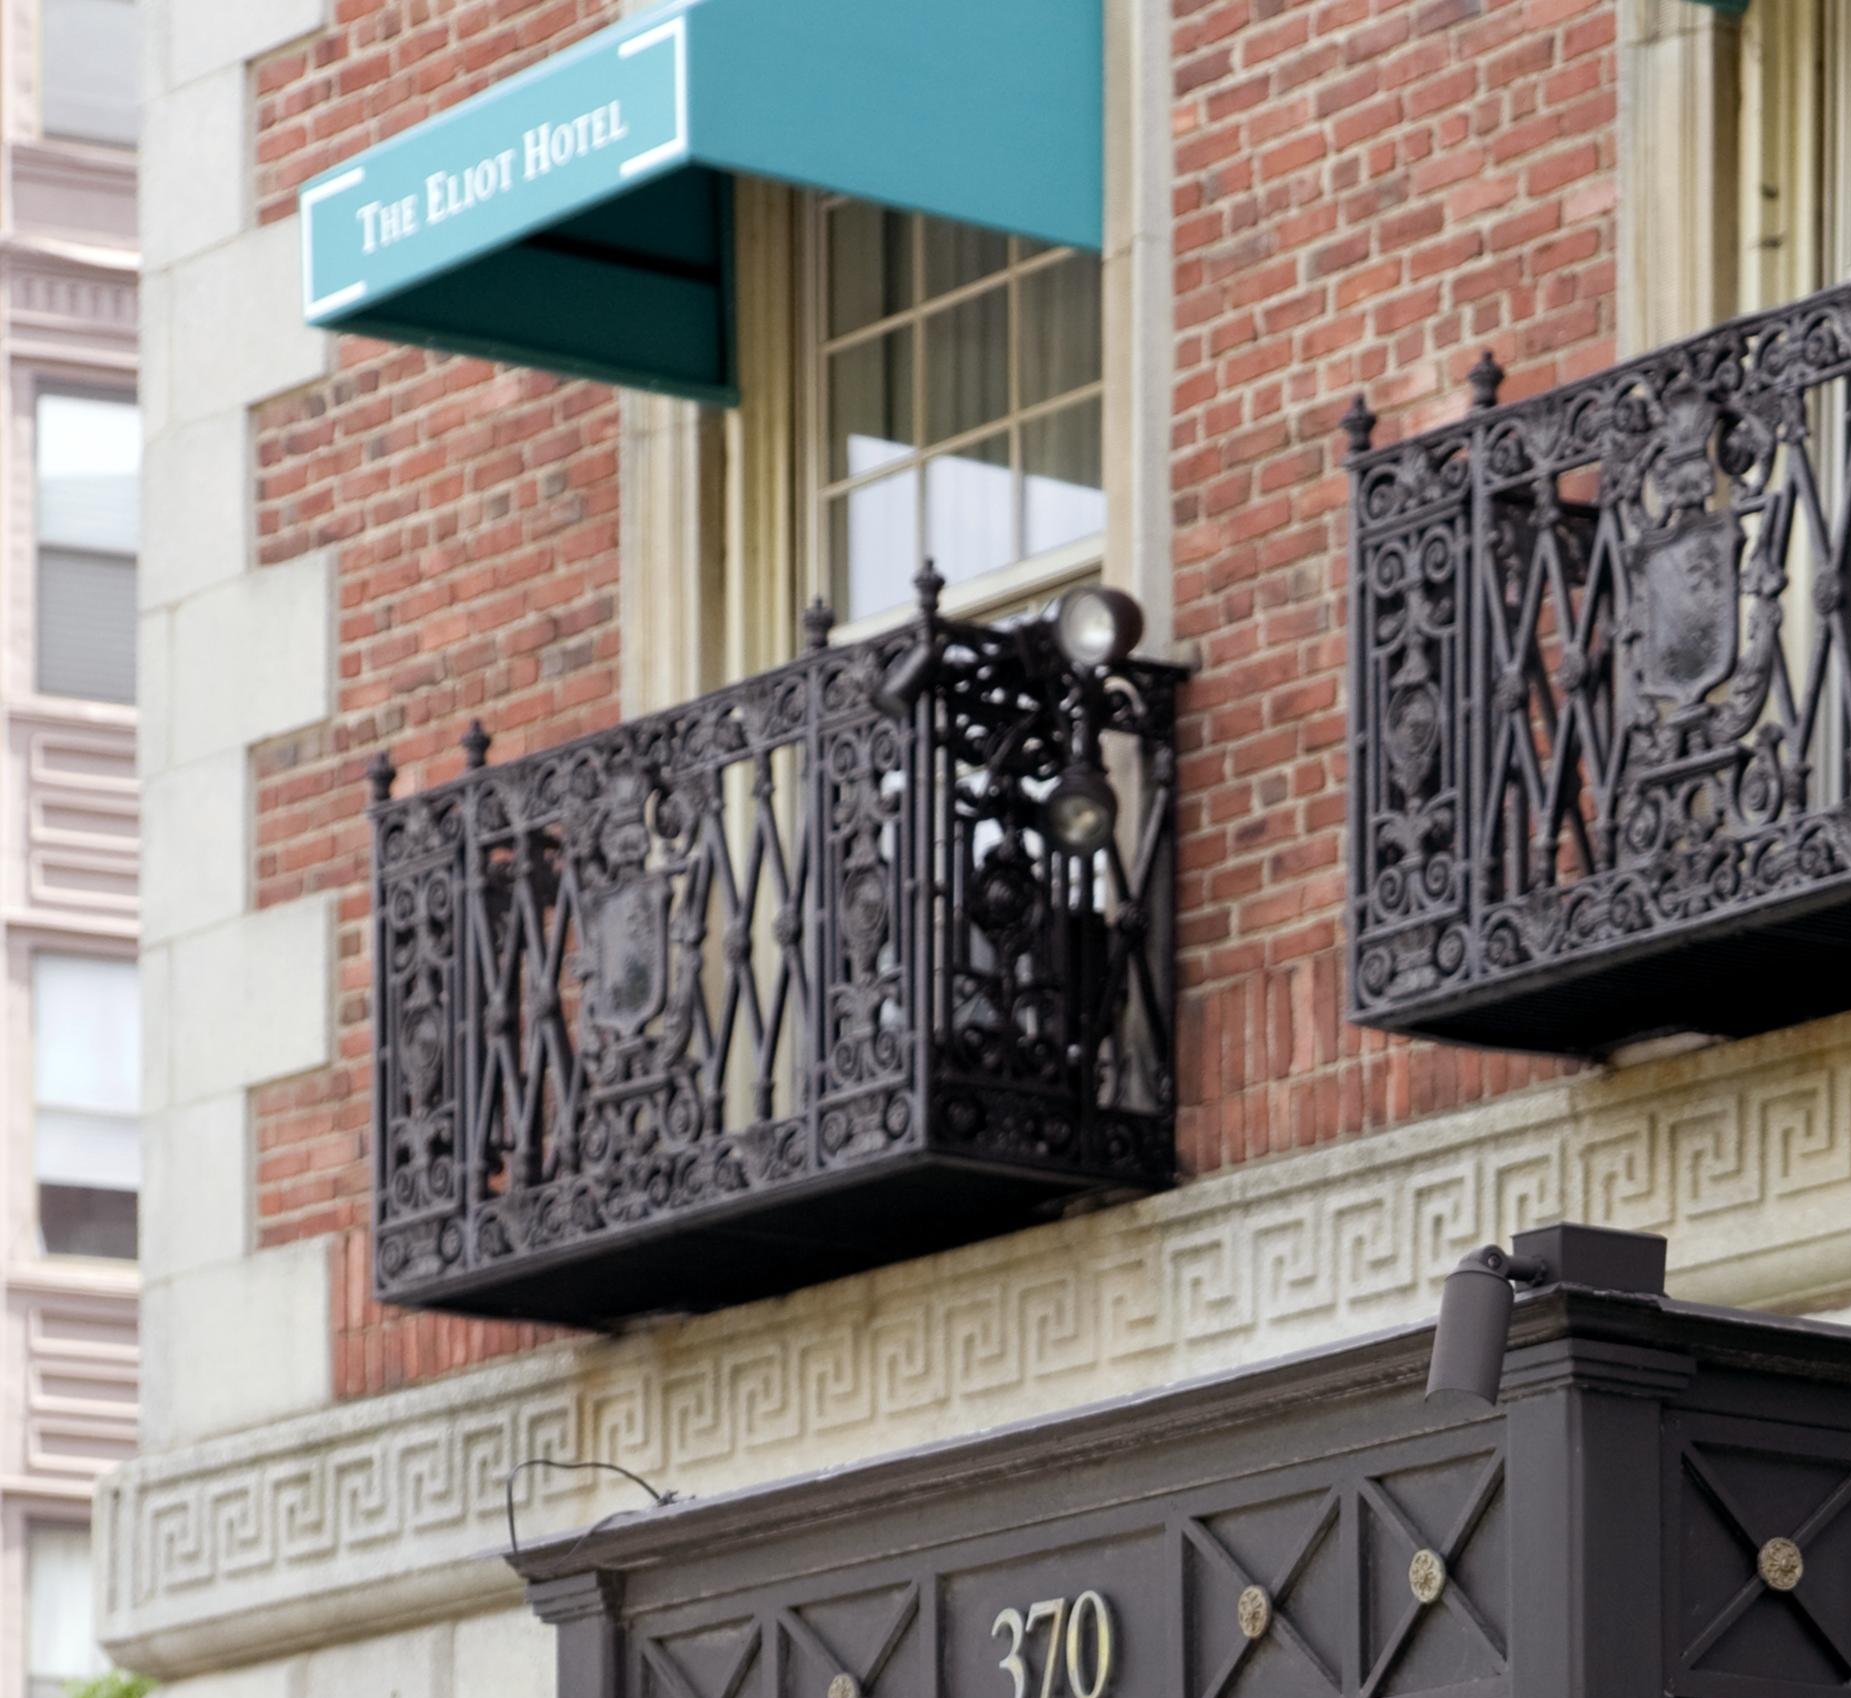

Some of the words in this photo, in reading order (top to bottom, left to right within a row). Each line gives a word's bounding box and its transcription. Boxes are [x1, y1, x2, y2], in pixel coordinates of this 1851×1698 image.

[356, 200, 421, 254] THE
[424, 148, 517, 226] ELIOT
[522, 99, 629, 182] HOTEL
